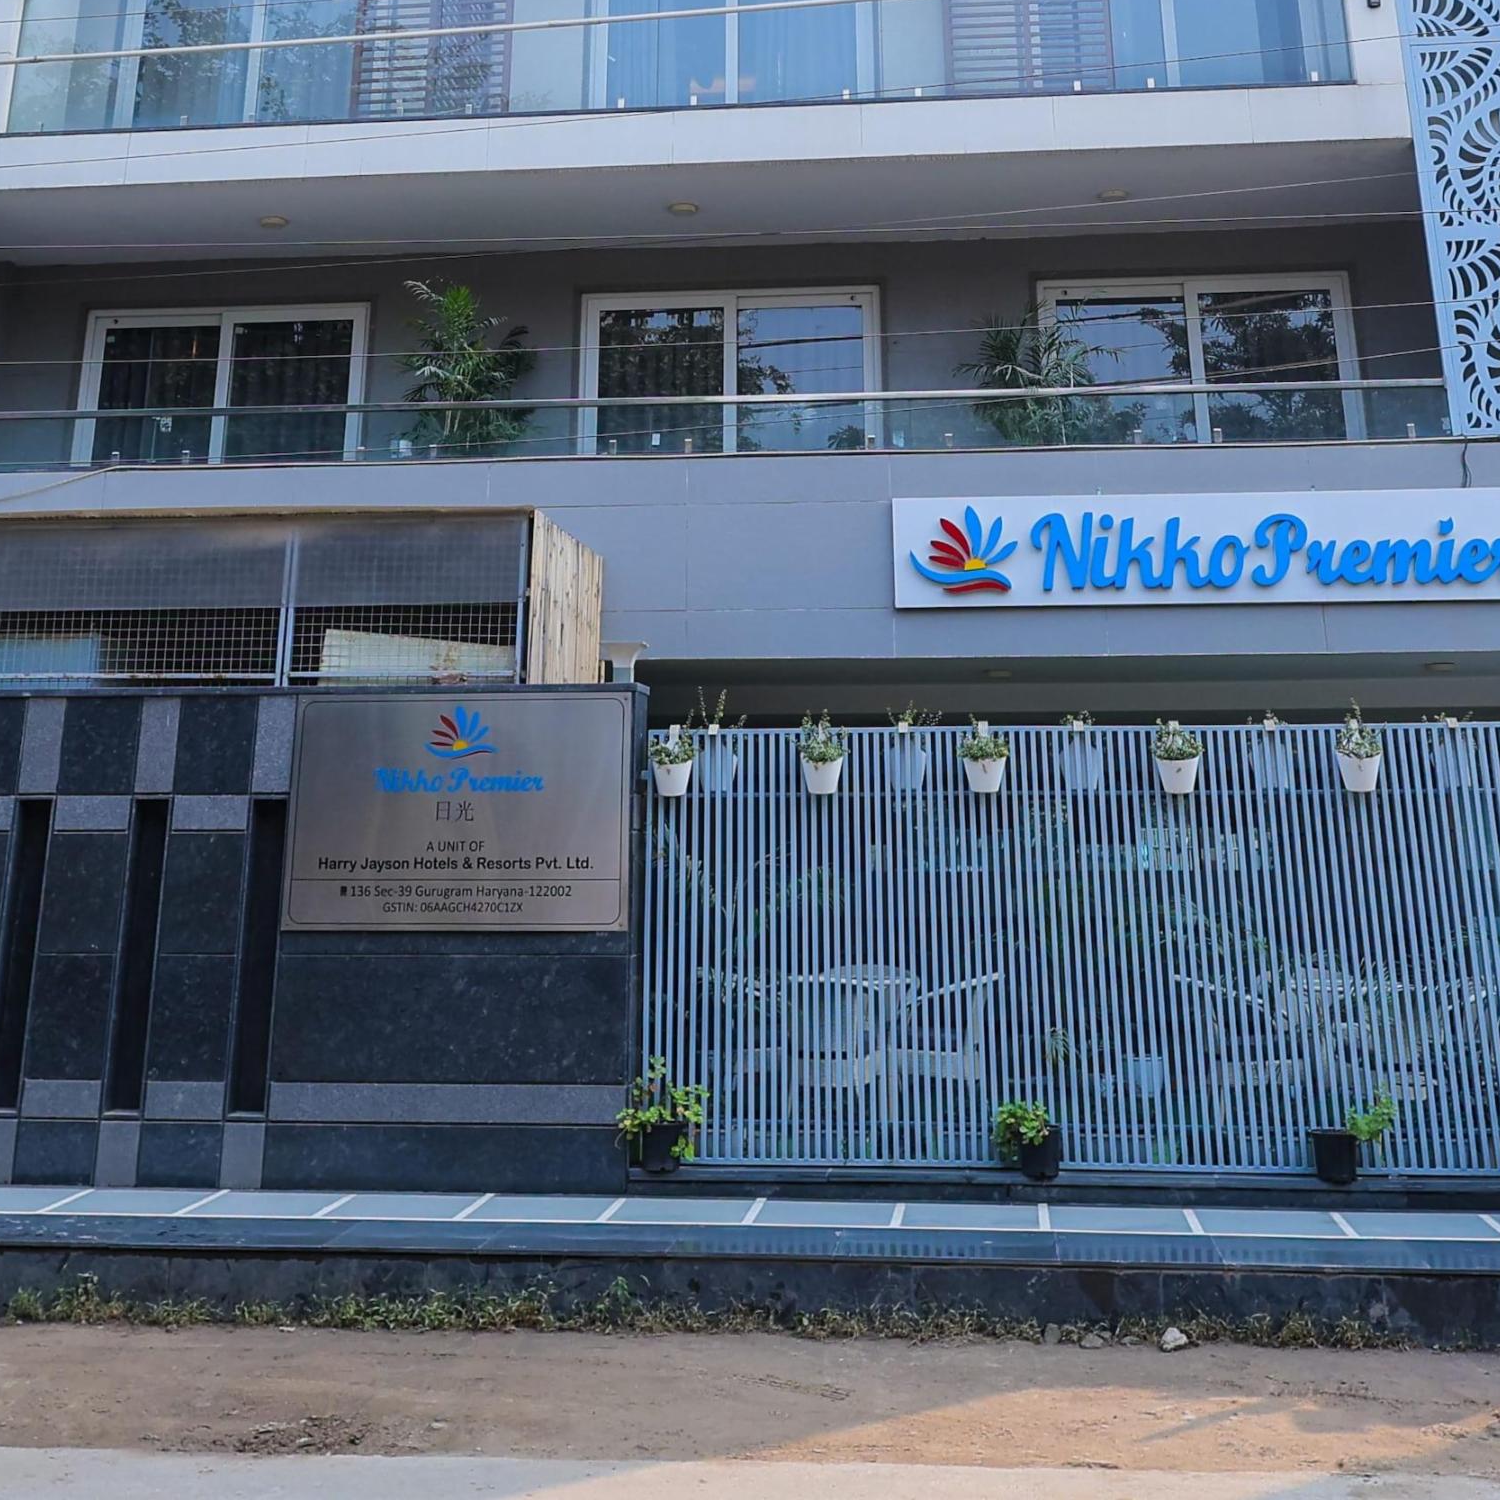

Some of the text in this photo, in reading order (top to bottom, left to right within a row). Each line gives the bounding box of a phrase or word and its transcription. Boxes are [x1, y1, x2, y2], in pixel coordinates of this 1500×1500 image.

[1030, 510, 1252, 592] Nikko
[447, 766, 544, 794] Premier
[435, 800, 474, 822] 日光
[426, 841, 485, 852] A UNIT OF
[318, 857, 594, 873] Harry Jayson Hotels & Resorts Pvt. Ltd.
[350, 885, 371, 897] 136
[374, 885, 412, 897] Sec-39
[415, 885, 473, 900] Gurugram
[476, 885, 572, 899] Haryana-122002
[382, 902, 418, 913] GSTIN:
